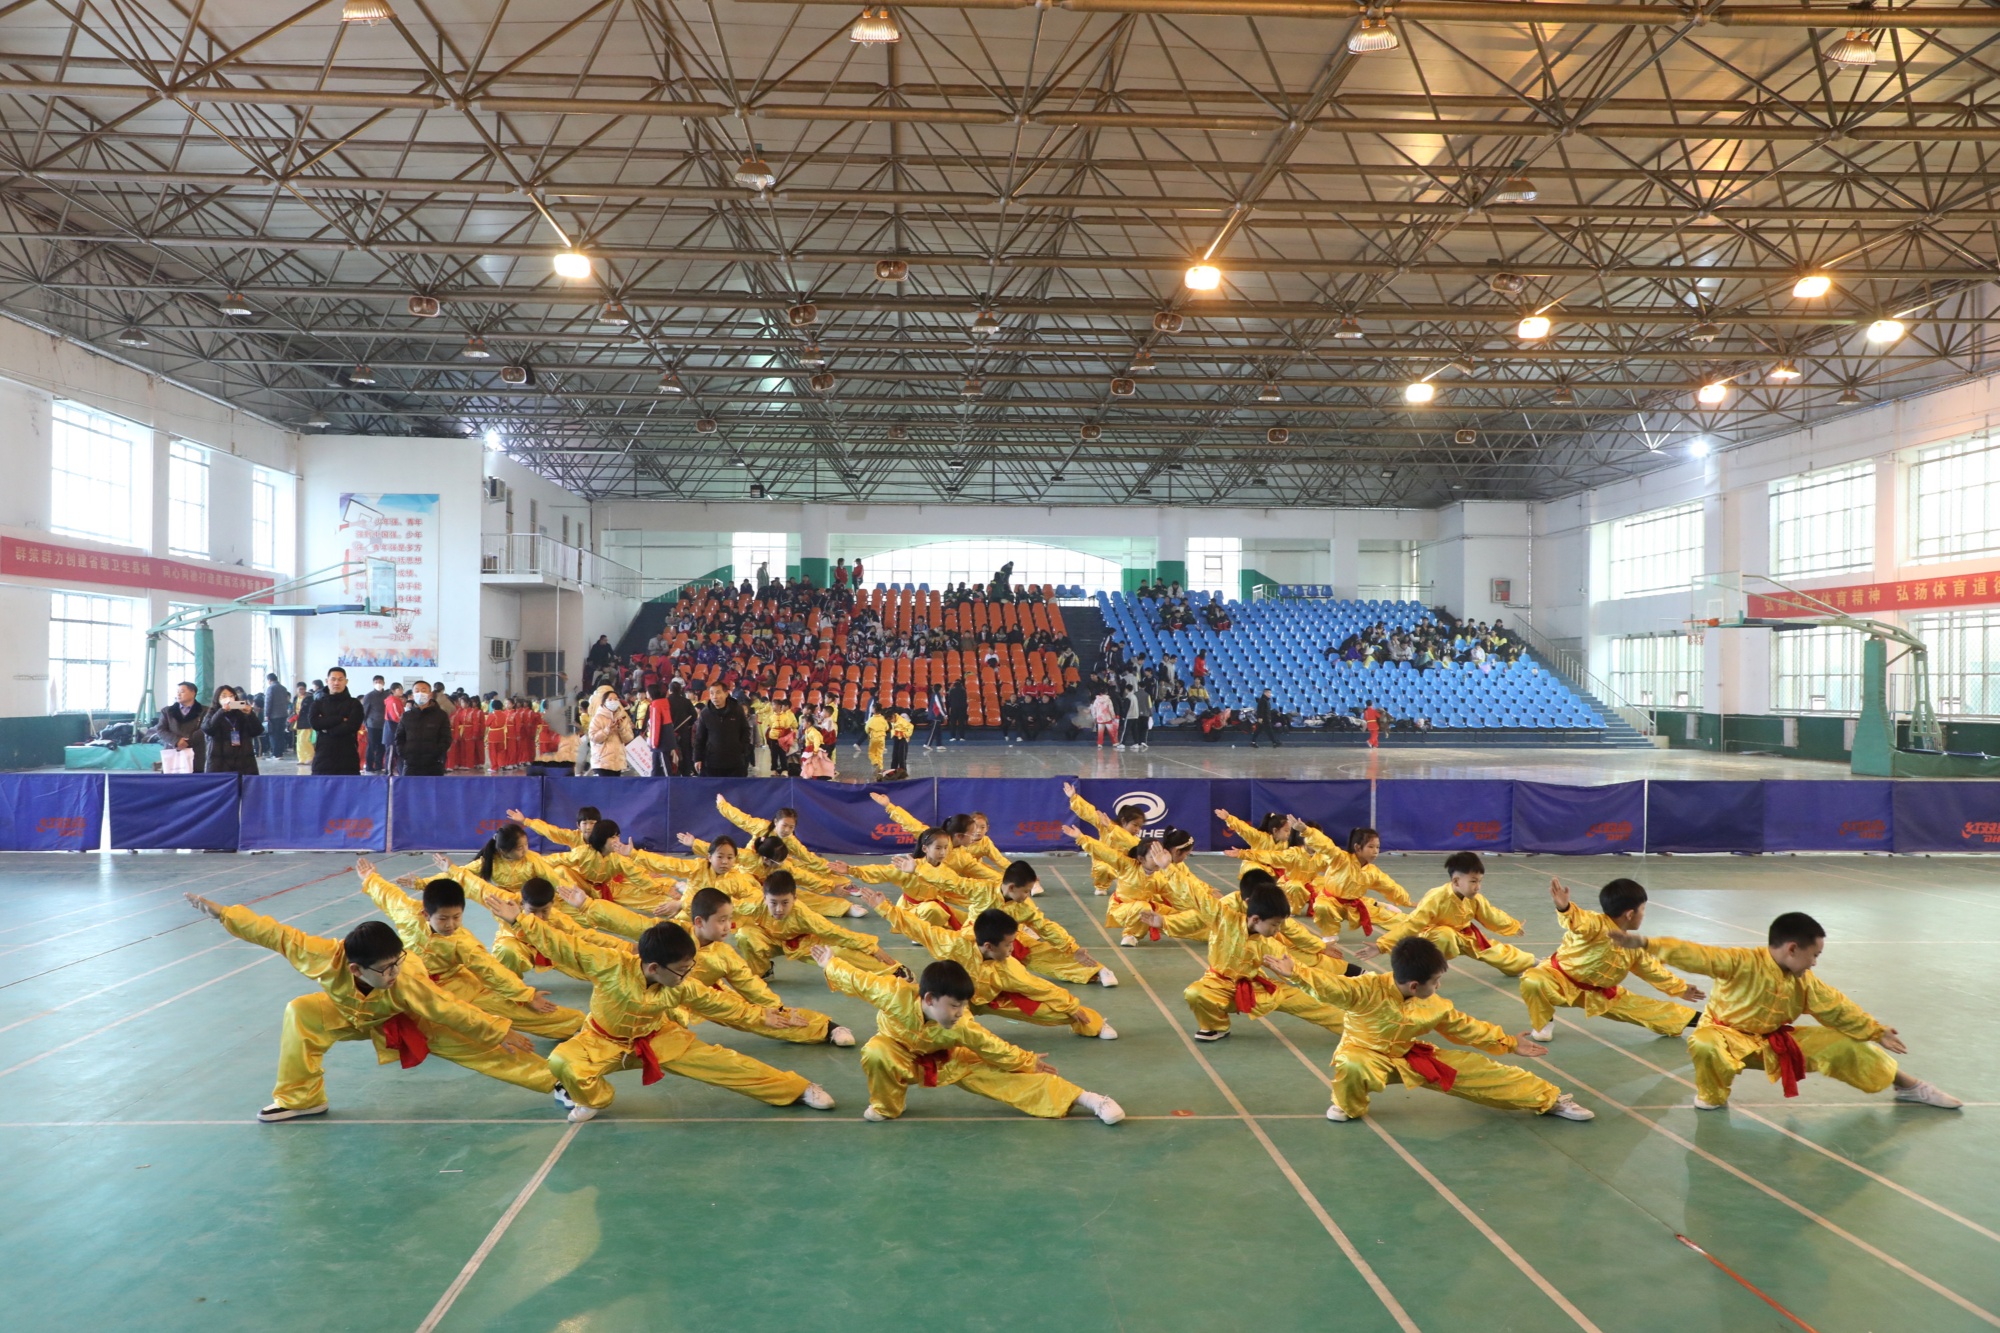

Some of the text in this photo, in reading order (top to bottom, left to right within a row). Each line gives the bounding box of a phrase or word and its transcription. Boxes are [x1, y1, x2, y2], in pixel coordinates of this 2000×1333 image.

[15, 546, 151, 576] 群策群力创建省级卫生县城
[1764, 587, 1881, 612] 弘扬中华体育精神
[896, 835, 918, 844] DH
